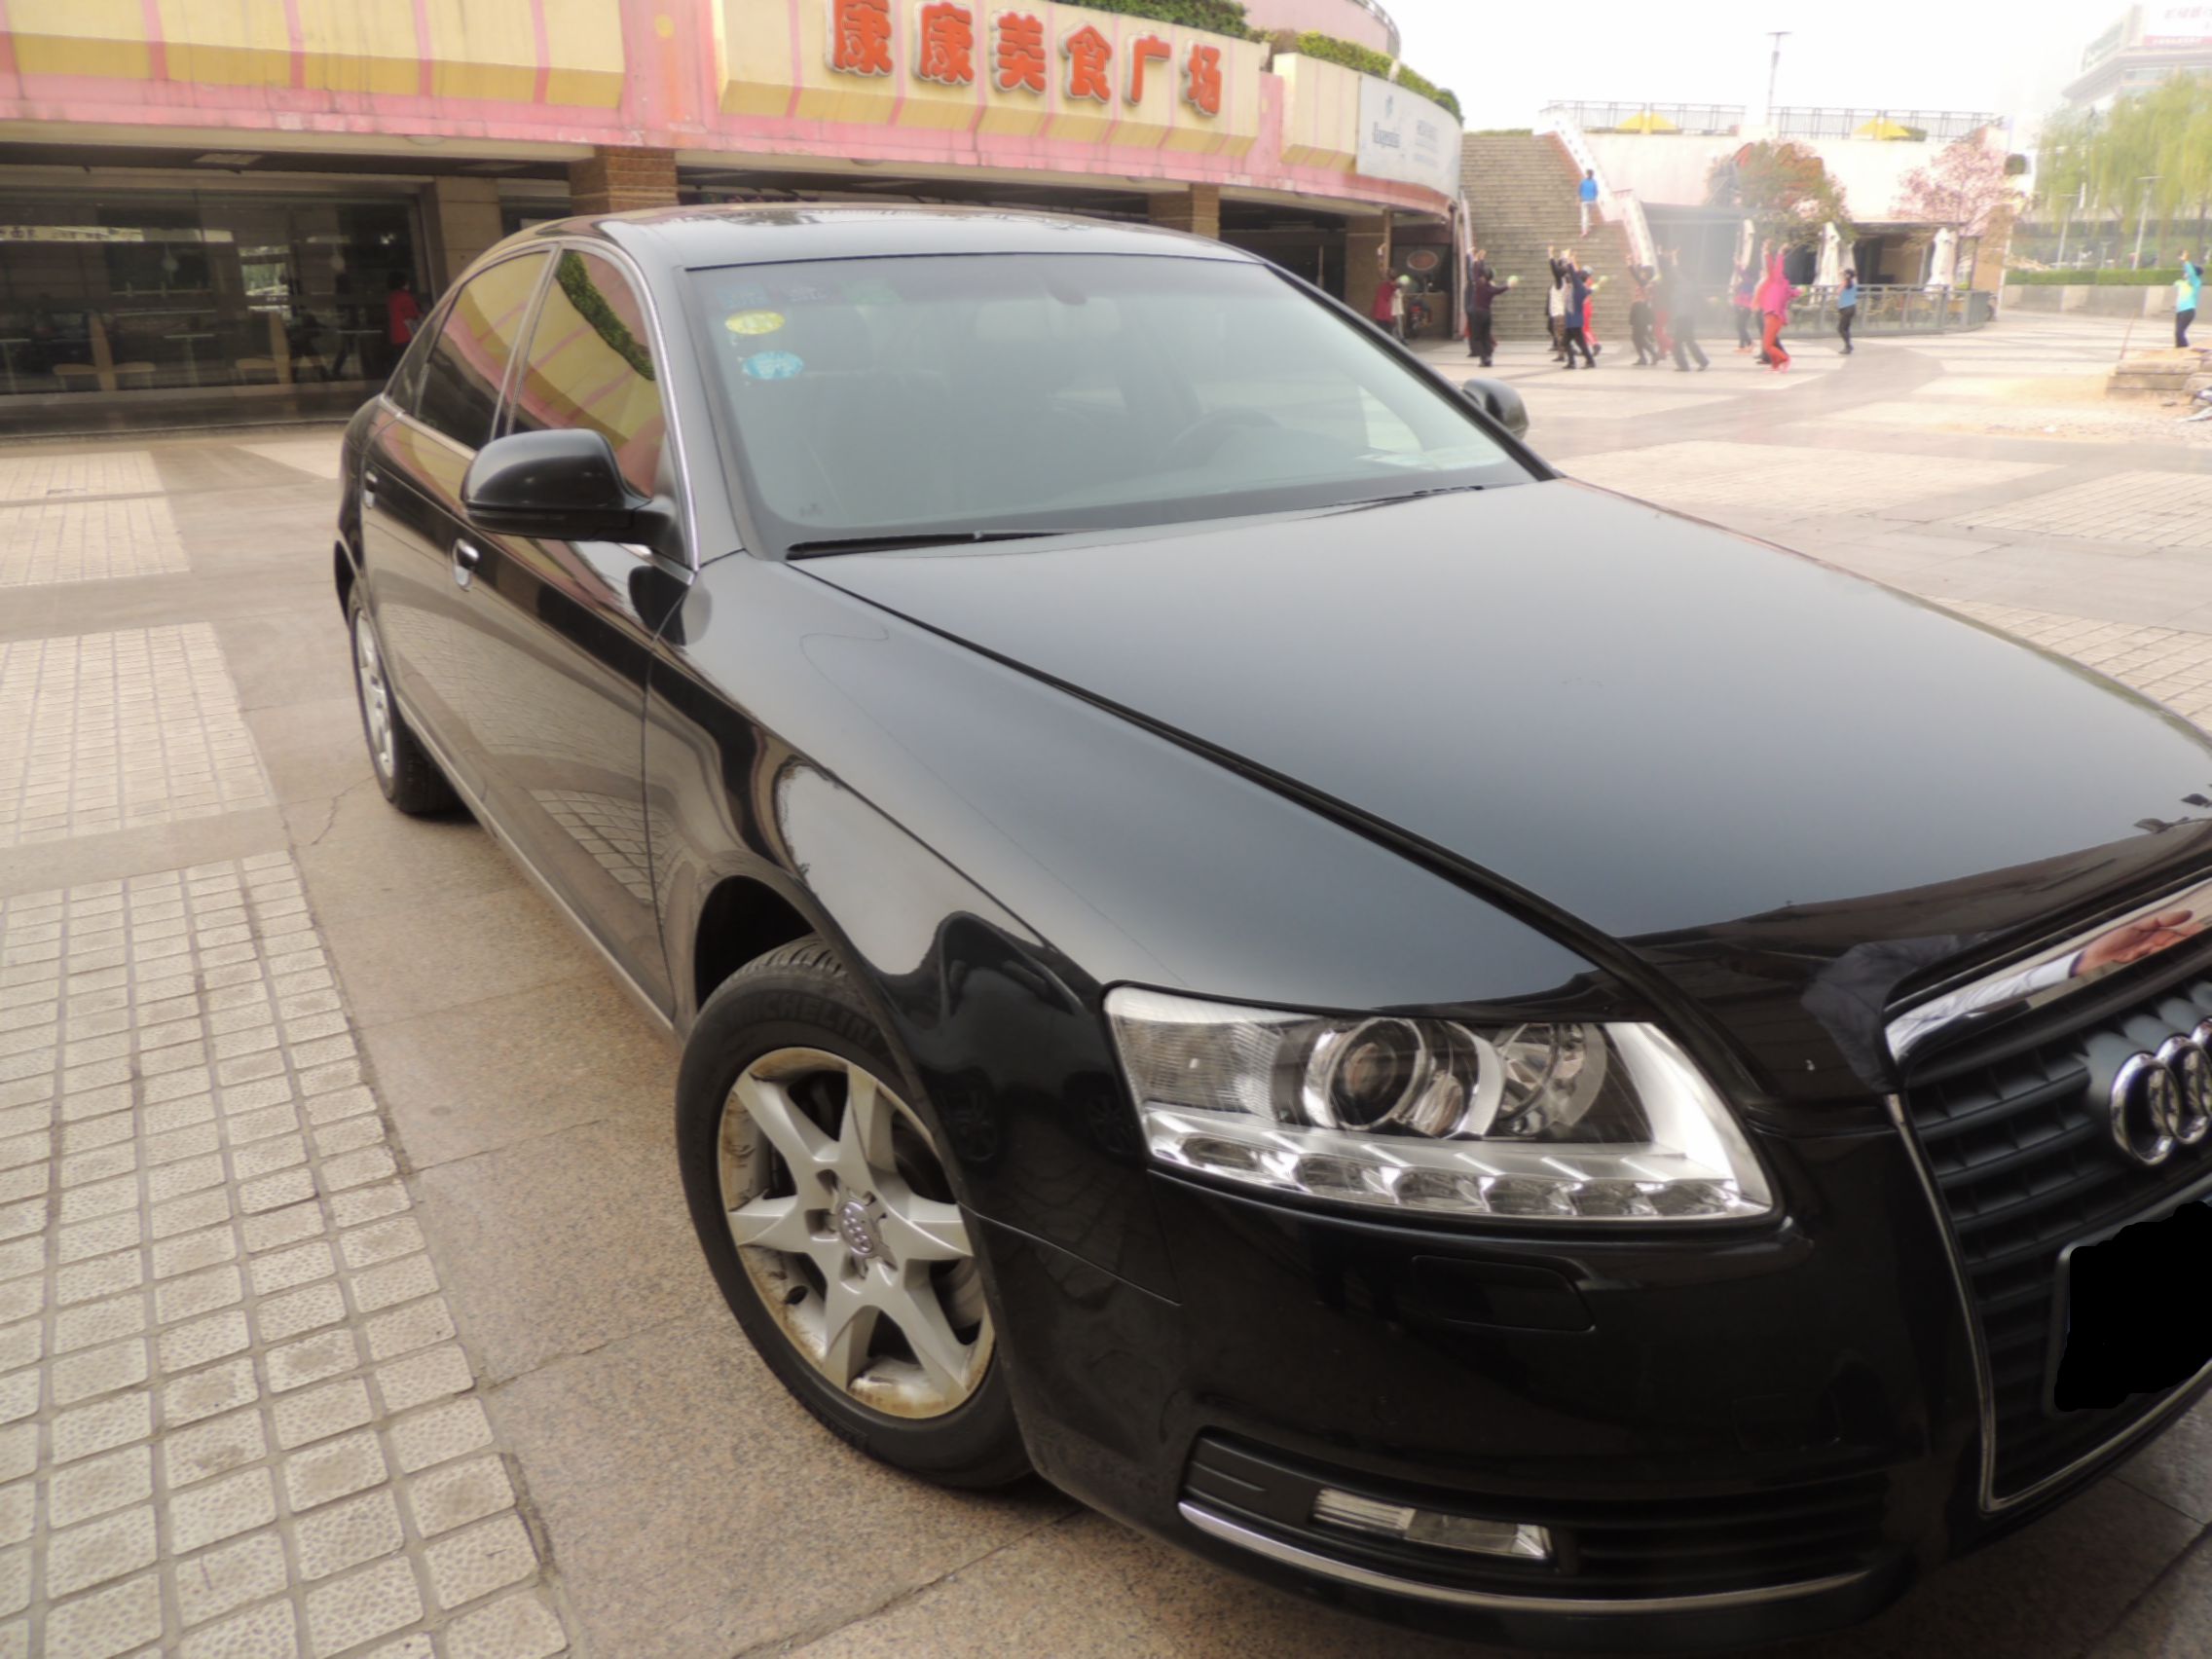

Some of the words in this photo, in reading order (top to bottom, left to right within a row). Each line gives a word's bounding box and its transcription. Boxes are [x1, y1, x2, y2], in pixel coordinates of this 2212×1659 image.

[830, 0, 1223, 116] 康康美食广场
[722, 991, 876, 1046] MICHELIN
